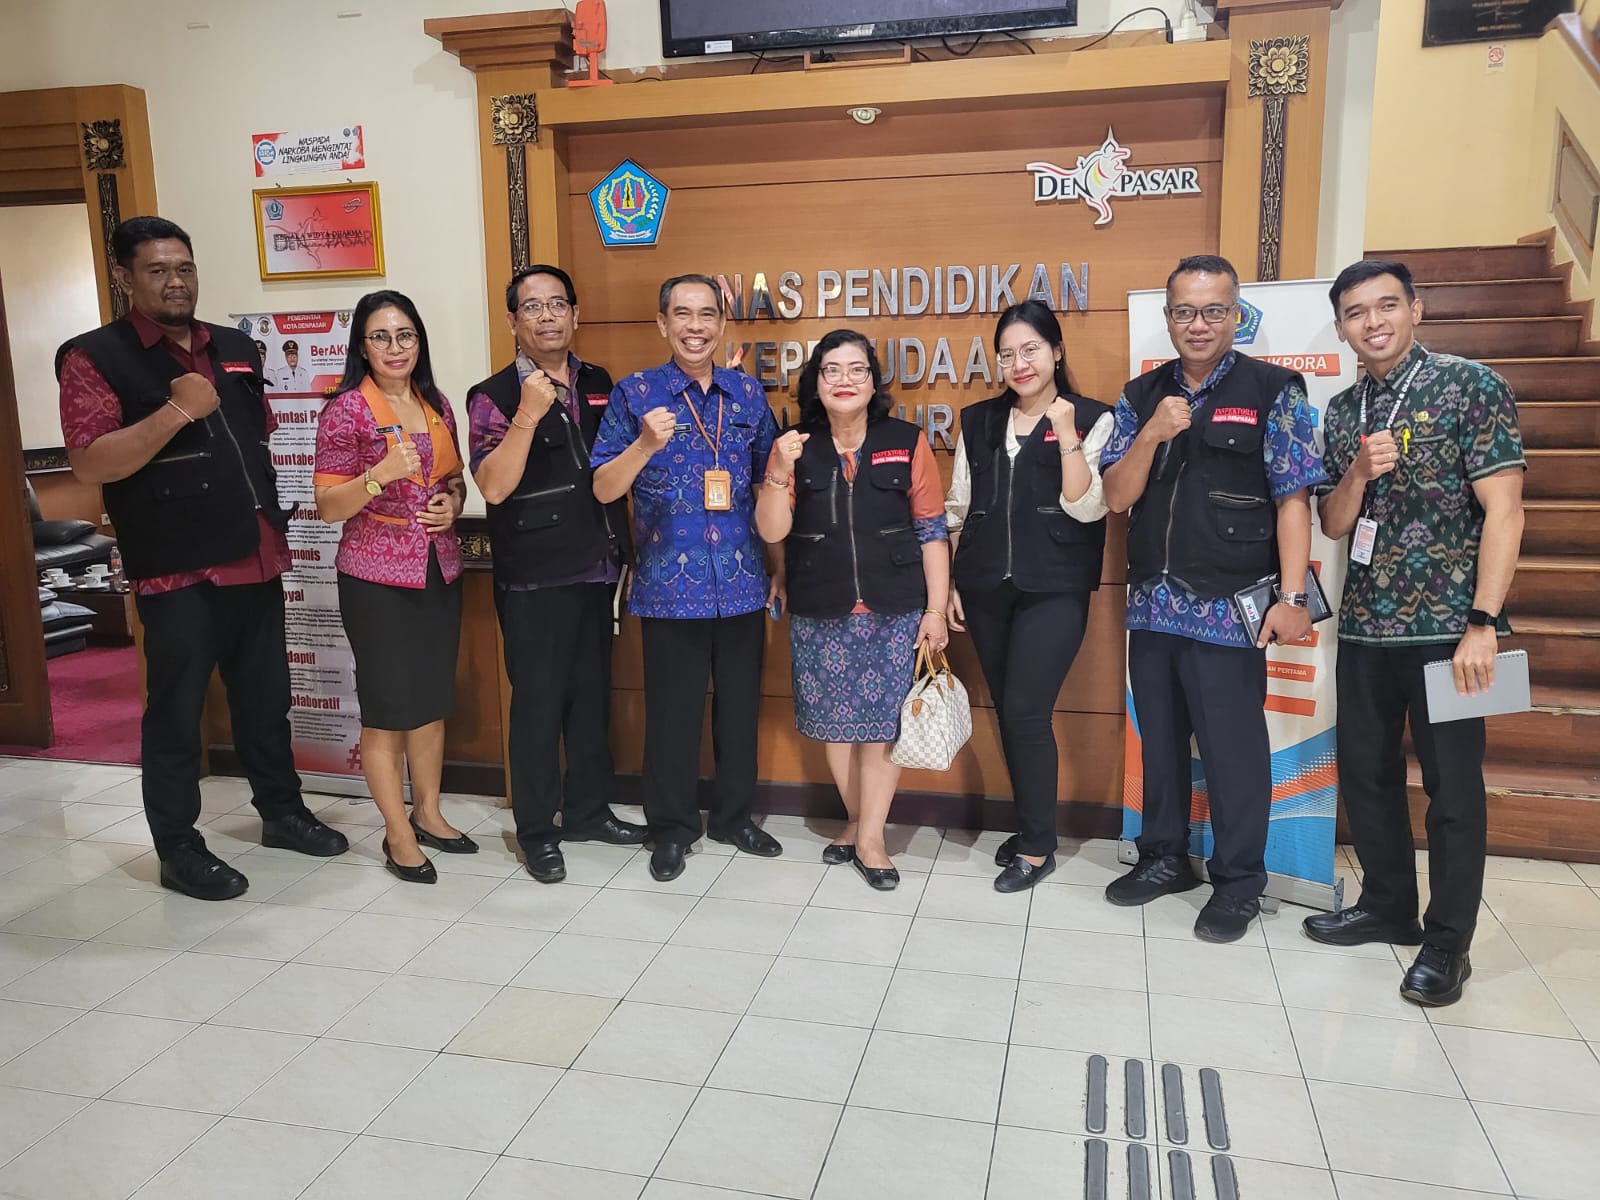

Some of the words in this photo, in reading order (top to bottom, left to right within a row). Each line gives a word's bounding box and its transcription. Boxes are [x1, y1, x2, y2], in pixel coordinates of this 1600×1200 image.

[298, 135, 330, 147] WASPADA
[278, 145, 310, 156] NARKOBA
[311, 142, 352, 154] MENGINTAI
[282, 153, 327, 164] LINGKUNGAN
[329, 151, 350, 160] ANDA!
[718, 272, 802, 320] NAS
[817, 262, 1090, 317] PENDIDIKAN
[272, 453, 314, 465] kuntabe
[290, 548, 320, 561] monis
